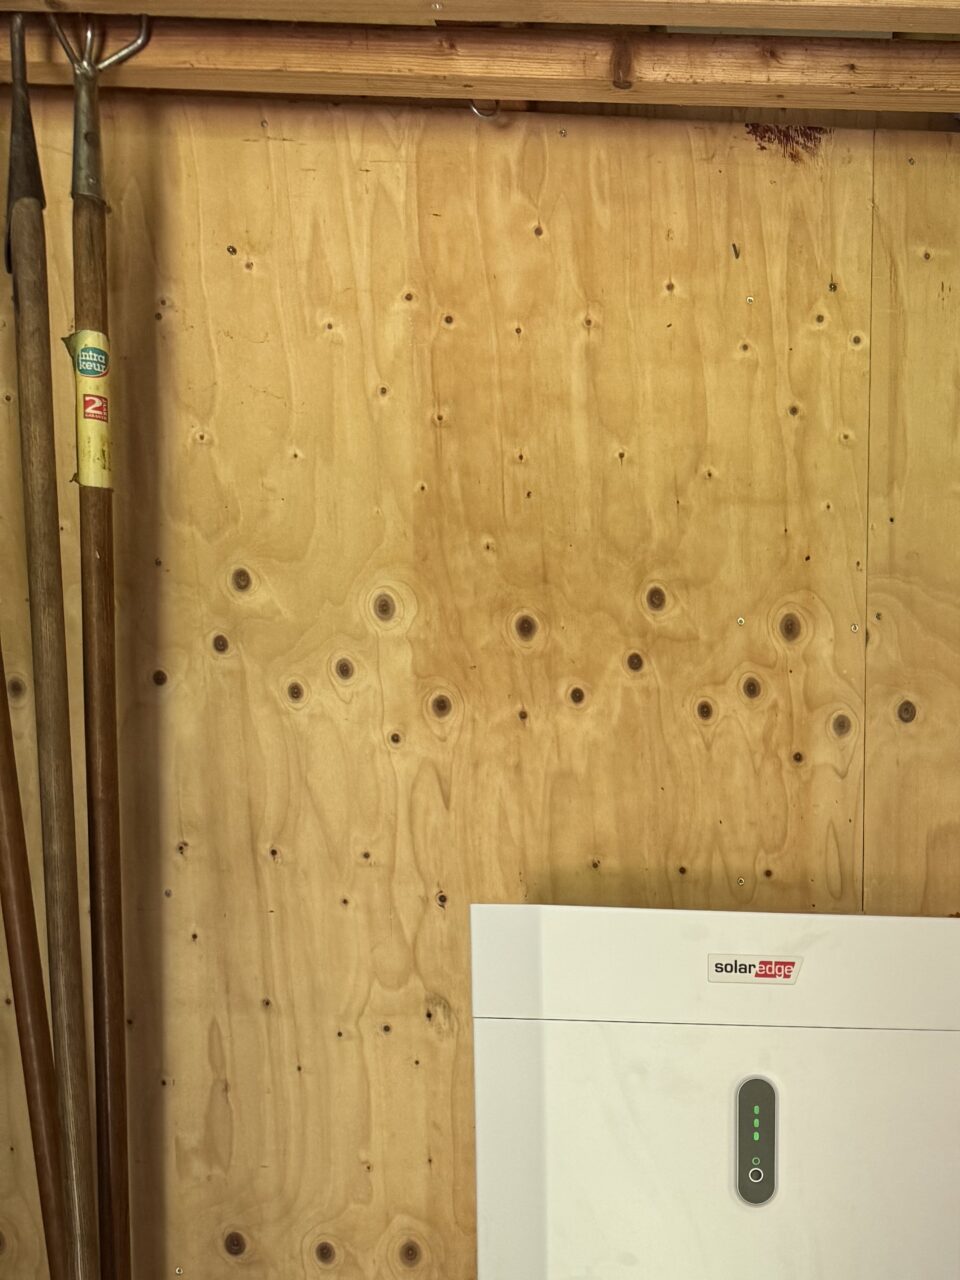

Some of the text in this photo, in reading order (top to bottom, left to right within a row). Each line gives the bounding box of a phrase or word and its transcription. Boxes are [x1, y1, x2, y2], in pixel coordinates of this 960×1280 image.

[78, 360, 106, 372] keur
[84, 396, 102, 415] 2
[714, 960, 795, 978] solaredge
